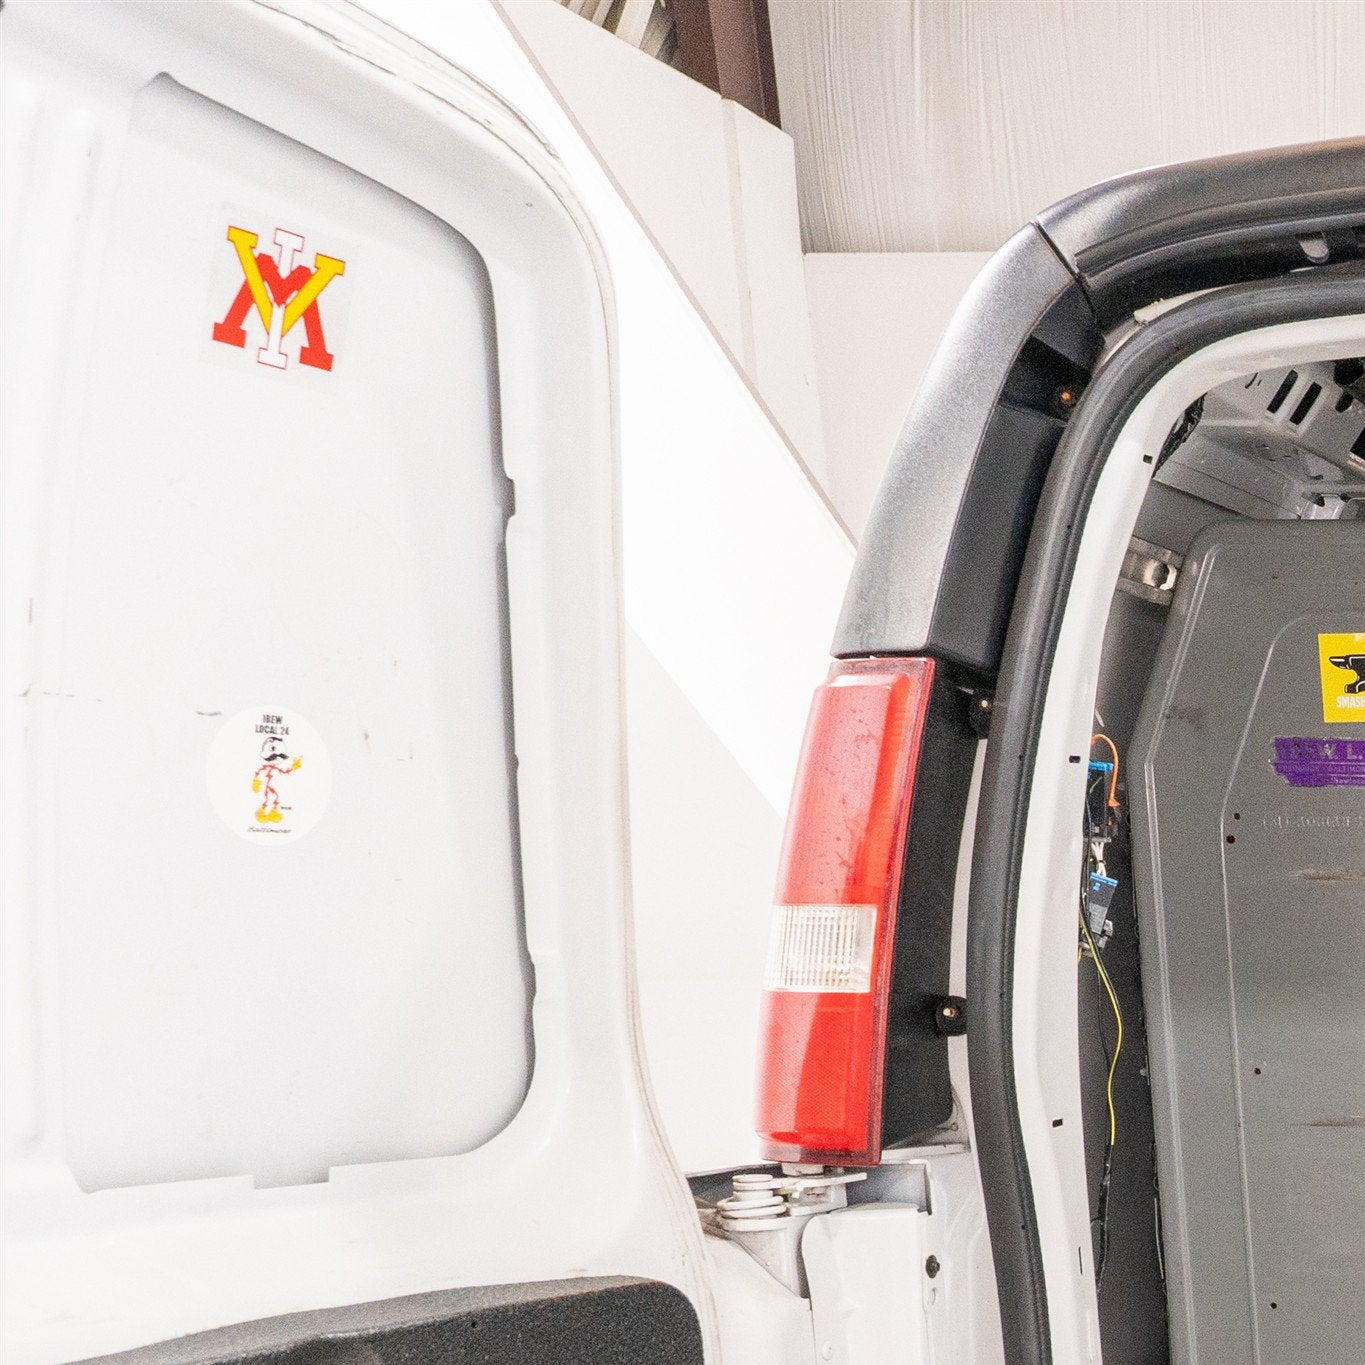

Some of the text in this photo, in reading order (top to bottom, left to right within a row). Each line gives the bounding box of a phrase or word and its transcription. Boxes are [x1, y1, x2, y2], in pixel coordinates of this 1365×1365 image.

[262, 714, 284, 724] IBEW
[255, 724, 290, 735] LOCAL 24
